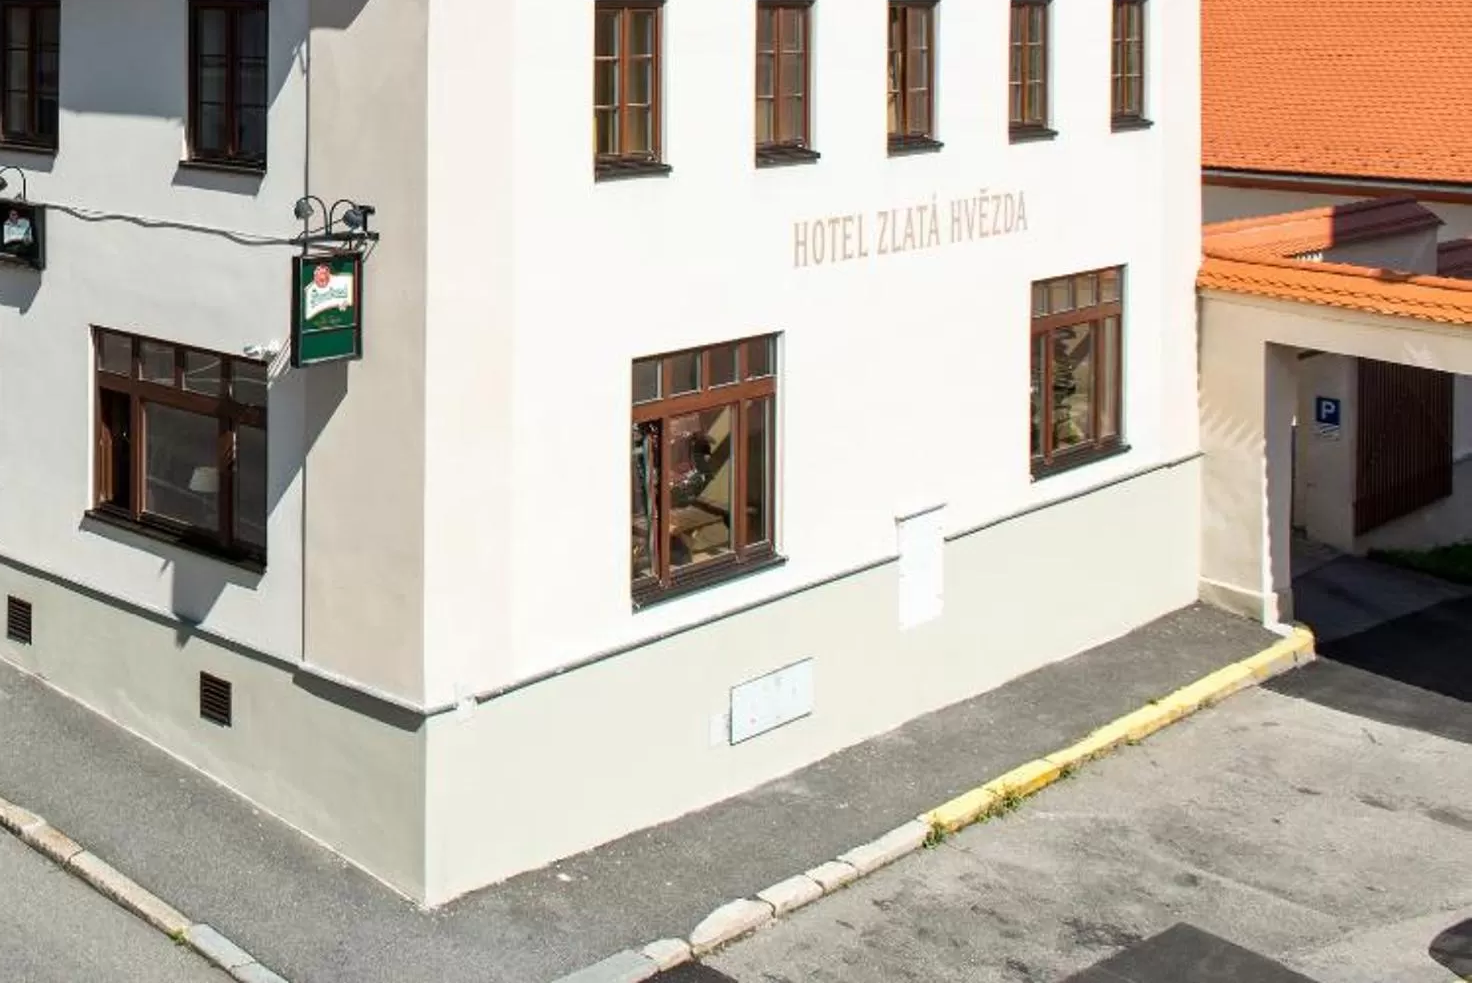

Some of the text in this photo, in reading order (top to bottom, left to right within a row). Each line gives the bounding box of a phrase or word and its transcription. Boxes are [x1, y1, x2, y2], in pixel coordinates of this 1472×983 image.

[792, 186, 1029, 269] HOTEL ZLATÁ HVĚZDA
[1321, 400, 1336, 420] P
